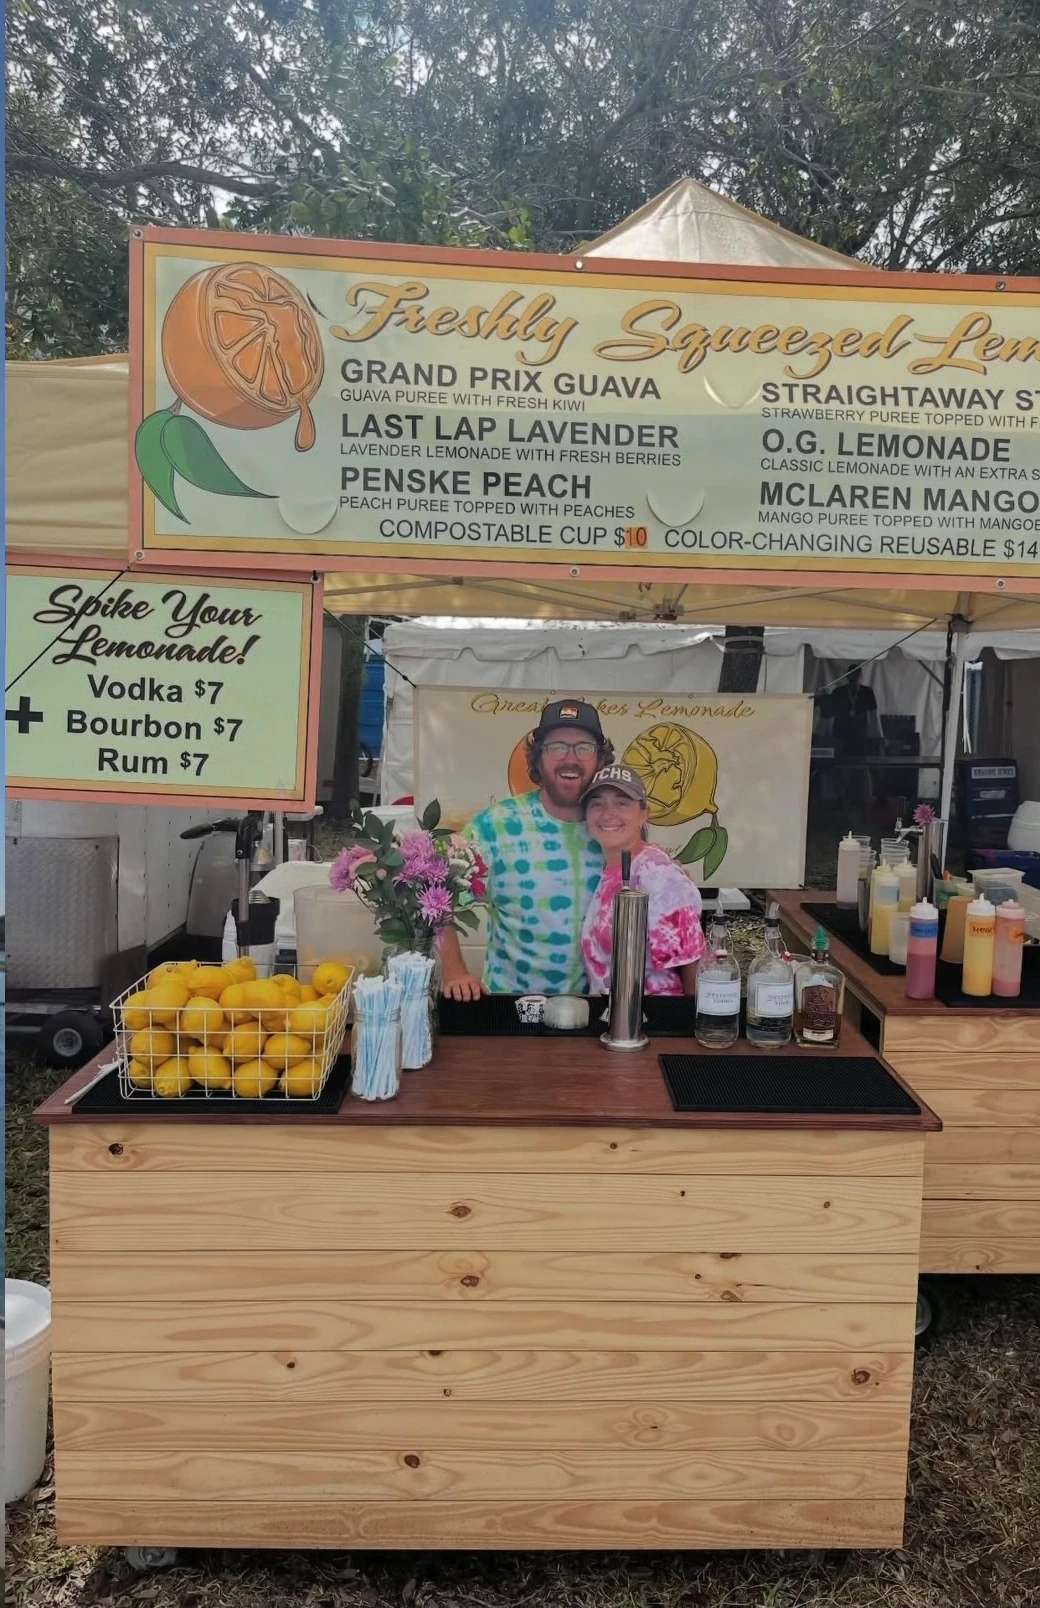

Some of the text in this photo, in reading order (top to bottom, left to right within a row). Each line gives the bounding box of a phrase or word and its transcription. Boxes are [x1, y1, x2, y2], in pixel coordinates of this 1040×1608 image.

[329, 281, 580, 366] Freshly
[593, 299, 914, 379] Squeezed
[340, 358, 661, 400] GRAND PRIX GUAVA
[339, 387, 586, 413] GUAVA PUREE WITH FRESH KIWI
[762, 382, 1005, 411] STRAIGHTAWAY
[341, 413, 680, 449] LAST LAP LAVENDER
[761, 407, 865, 422] STRAWBERRY
[870, 410, 920, 425] PUREE
[925, 413, 984, 427] TOPPED
[988, 415, 1026, 429] WITH
[340, 443, 682, 467] LAVENDER LEMONADE WITH FRESH BERRIES
[762, 428, 1012, 463] O.G. LEMONADE
[341, 466, 592, 499] PENSKE PEACH
[760, 457, 824, 472] CLASSIC
[828, 460, 910, 476] LEMONADE
[914, 464, 951, 478] WITH
[955, 466, 975, 479] AN
[979, 467, 1028, 481] EXTRA
[339, 495, 635, 519] PEACH PUREE TOPPED WITH PEACHES
[760, 481, 1040, 514] MCLAREN MANGO
[380, 519, 648, 549] COMPOSTABLE CUP $10
[758, 511, 814, 525] MANGO
[818, 513, 869, 526] PUREE
[873, 515, 933, 528] TOPPED
[937, 517, 975, 530] WITH
[664, 528, 1039, 560] COLOR-CHANGING REUSABLE $14
[33, 584, 263, 638] Spike Your
[52, 624, 262, 666] Lemonade!
[87, 674, 225, 705] Vodka $7
[633, 699, 756, 719] Lemonade
[66, 709, 244, 742] Bourbon $7
[98, 747, 210, 776] Rum $7
